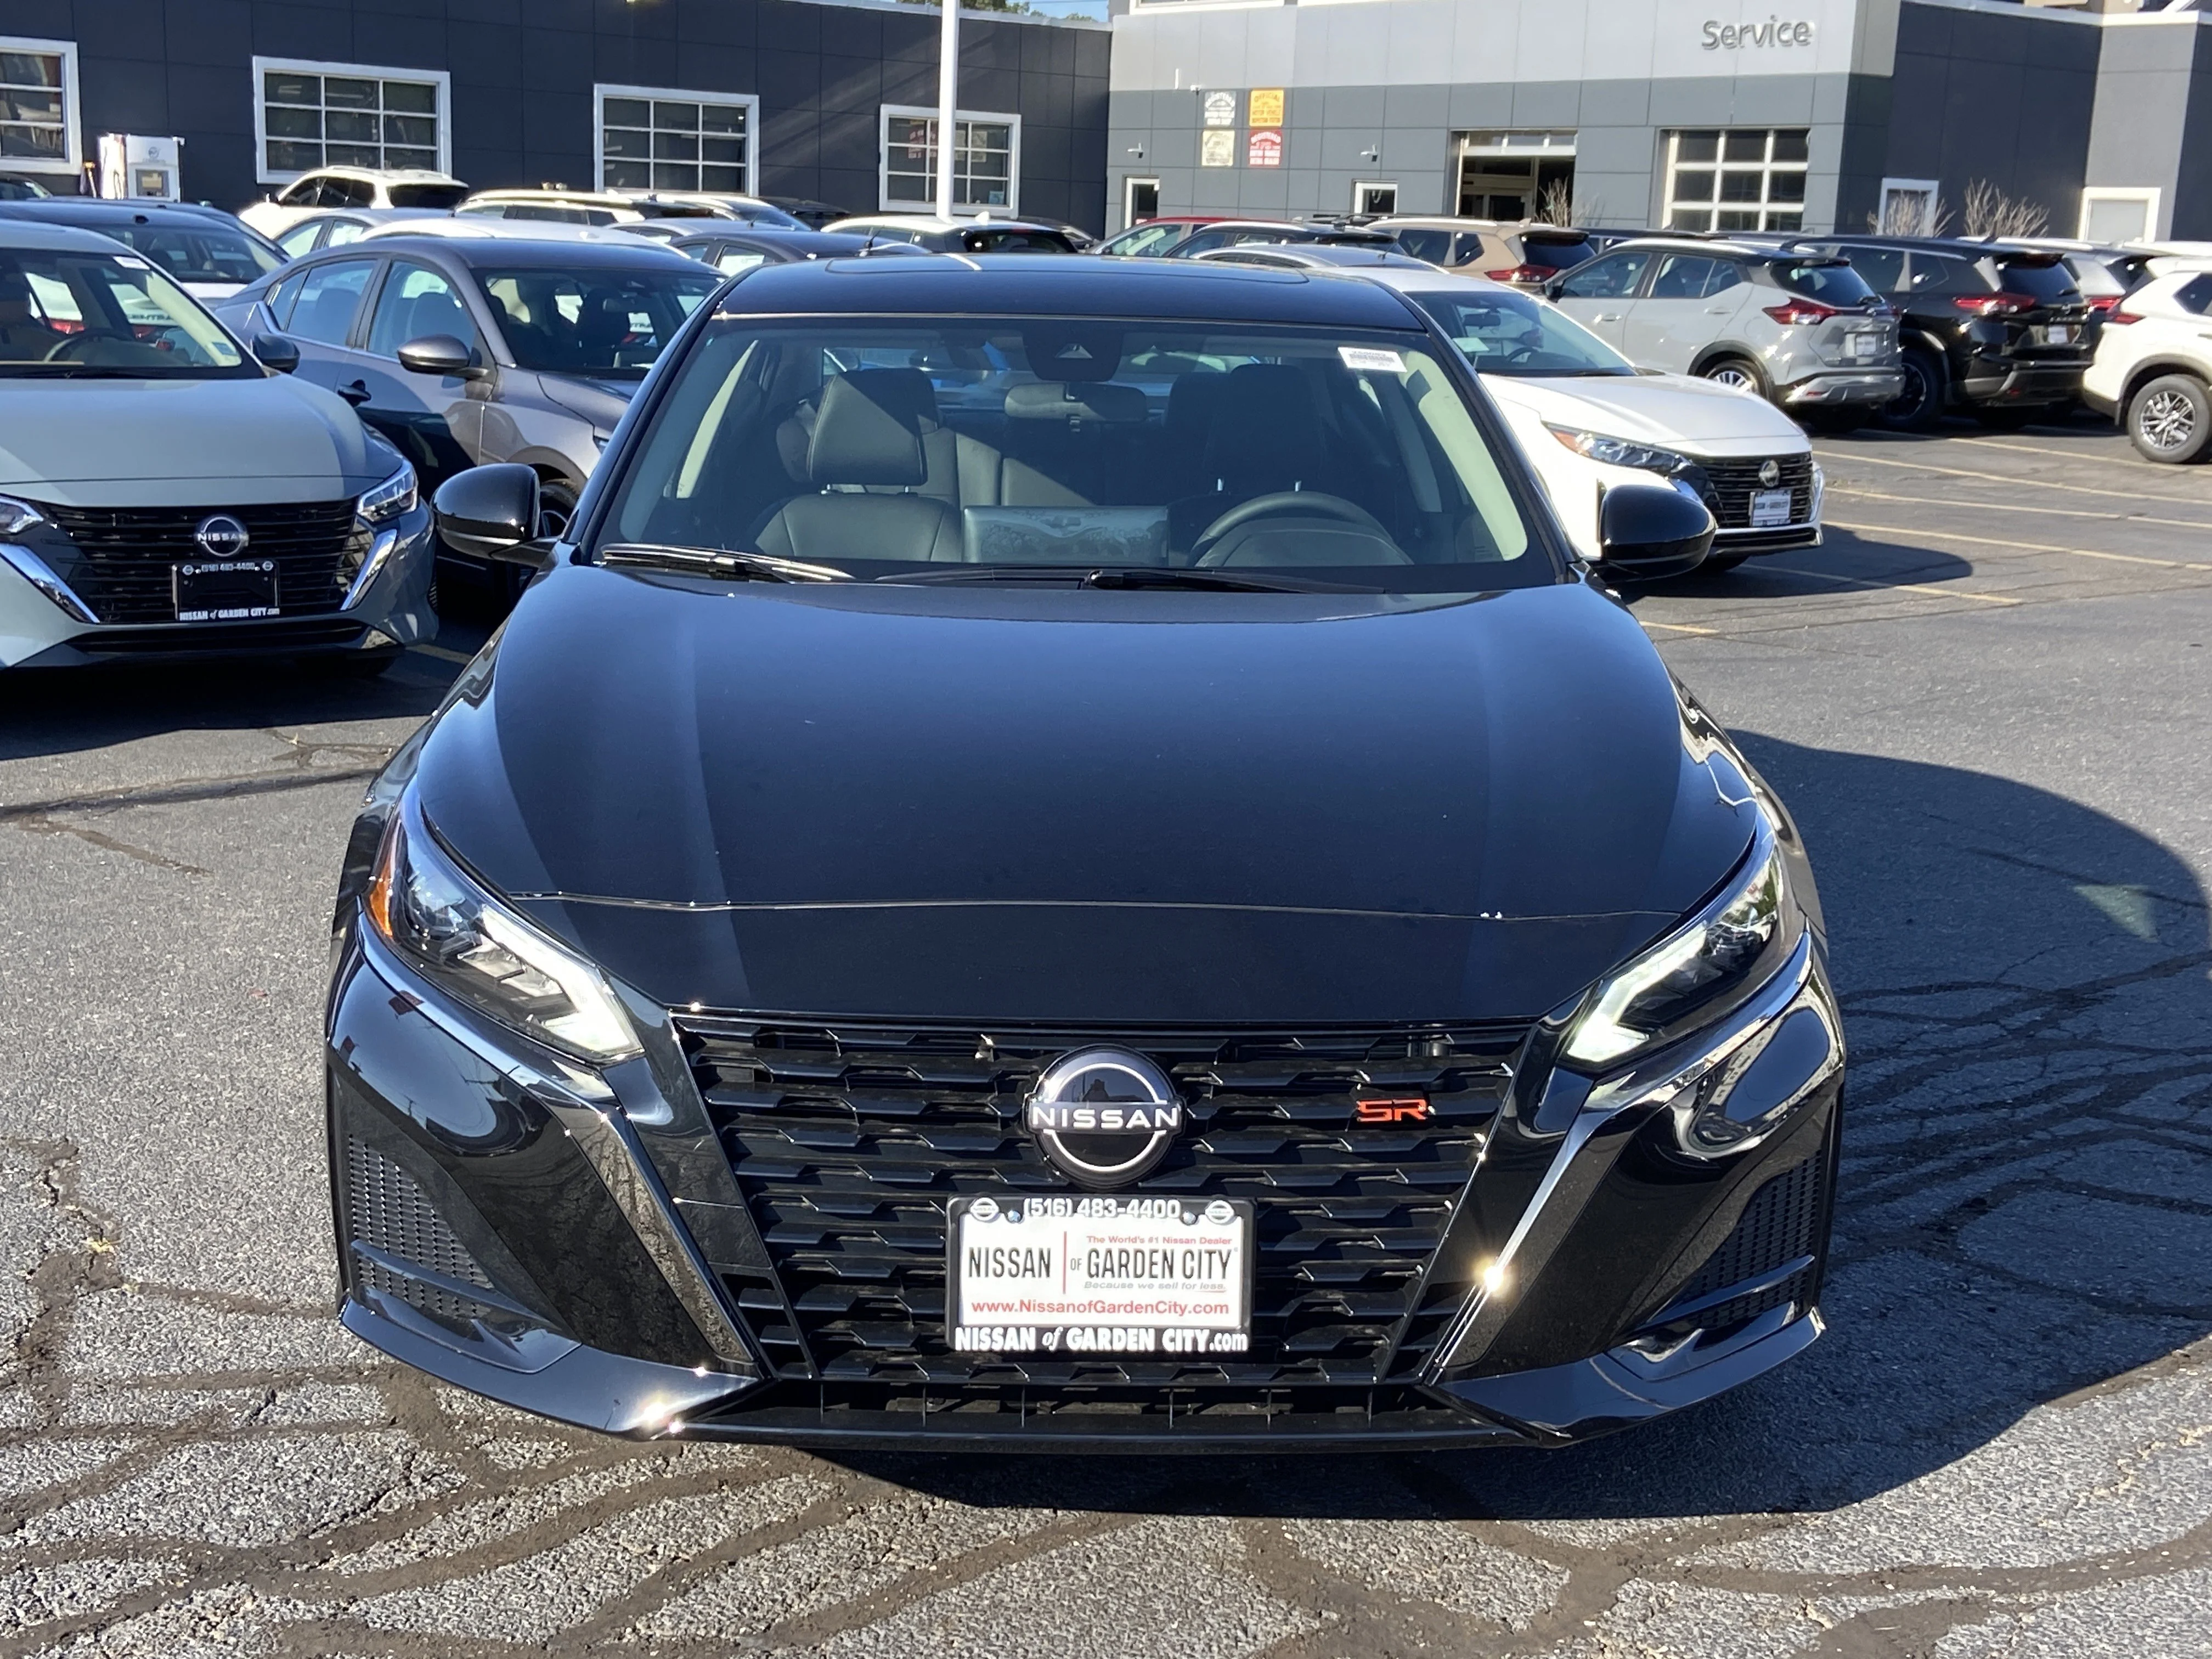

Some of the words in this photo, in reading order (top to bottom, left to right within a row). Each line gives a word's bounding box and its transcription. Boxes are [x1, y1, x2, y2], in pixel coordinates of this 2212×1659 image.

[1702, 14, 1813, 50] Service
[198, 532, 249, 541] NISSAN
[179, 611, 208, 621] NISSAN
[210, 610, 217, 619] of
[218, 608, 249, 618] GARDEN
[1032, 1106, 1180, 1129] NISSAN
[1356, 1099, 1427, 1122] SR
[1024, 1198, 1073, 1217] (516)
[1076, 1198, 1181, 1218] 483-4400
[1108, 1235, 1146, 1244] World's
[1199, 1237, 1233, 1245] Dealer
[968, 1247, 1051, 1278] NISSAN
[1070, 1258, 1082, 1271] OF
[1087, 1248, 1175, 1279] GARDEN
[1182, 1248, 1232, 1279] CITY
[1084, 1281, 1134, 1289] Because
[1158, 1282, 1178, 1290] sell
[1181, 1282, 1197, 1290] for
[971, 1299, 1229, 1317] www.NissanofGardenCity.com
[955, 1327, 1036, 1351] NISSAN
[1042, 1326, 1063, 1351] of
[1066, 1327, 1155, 1351] GARDEN
[1161, 1328, 1249, 1352] CITY.com
